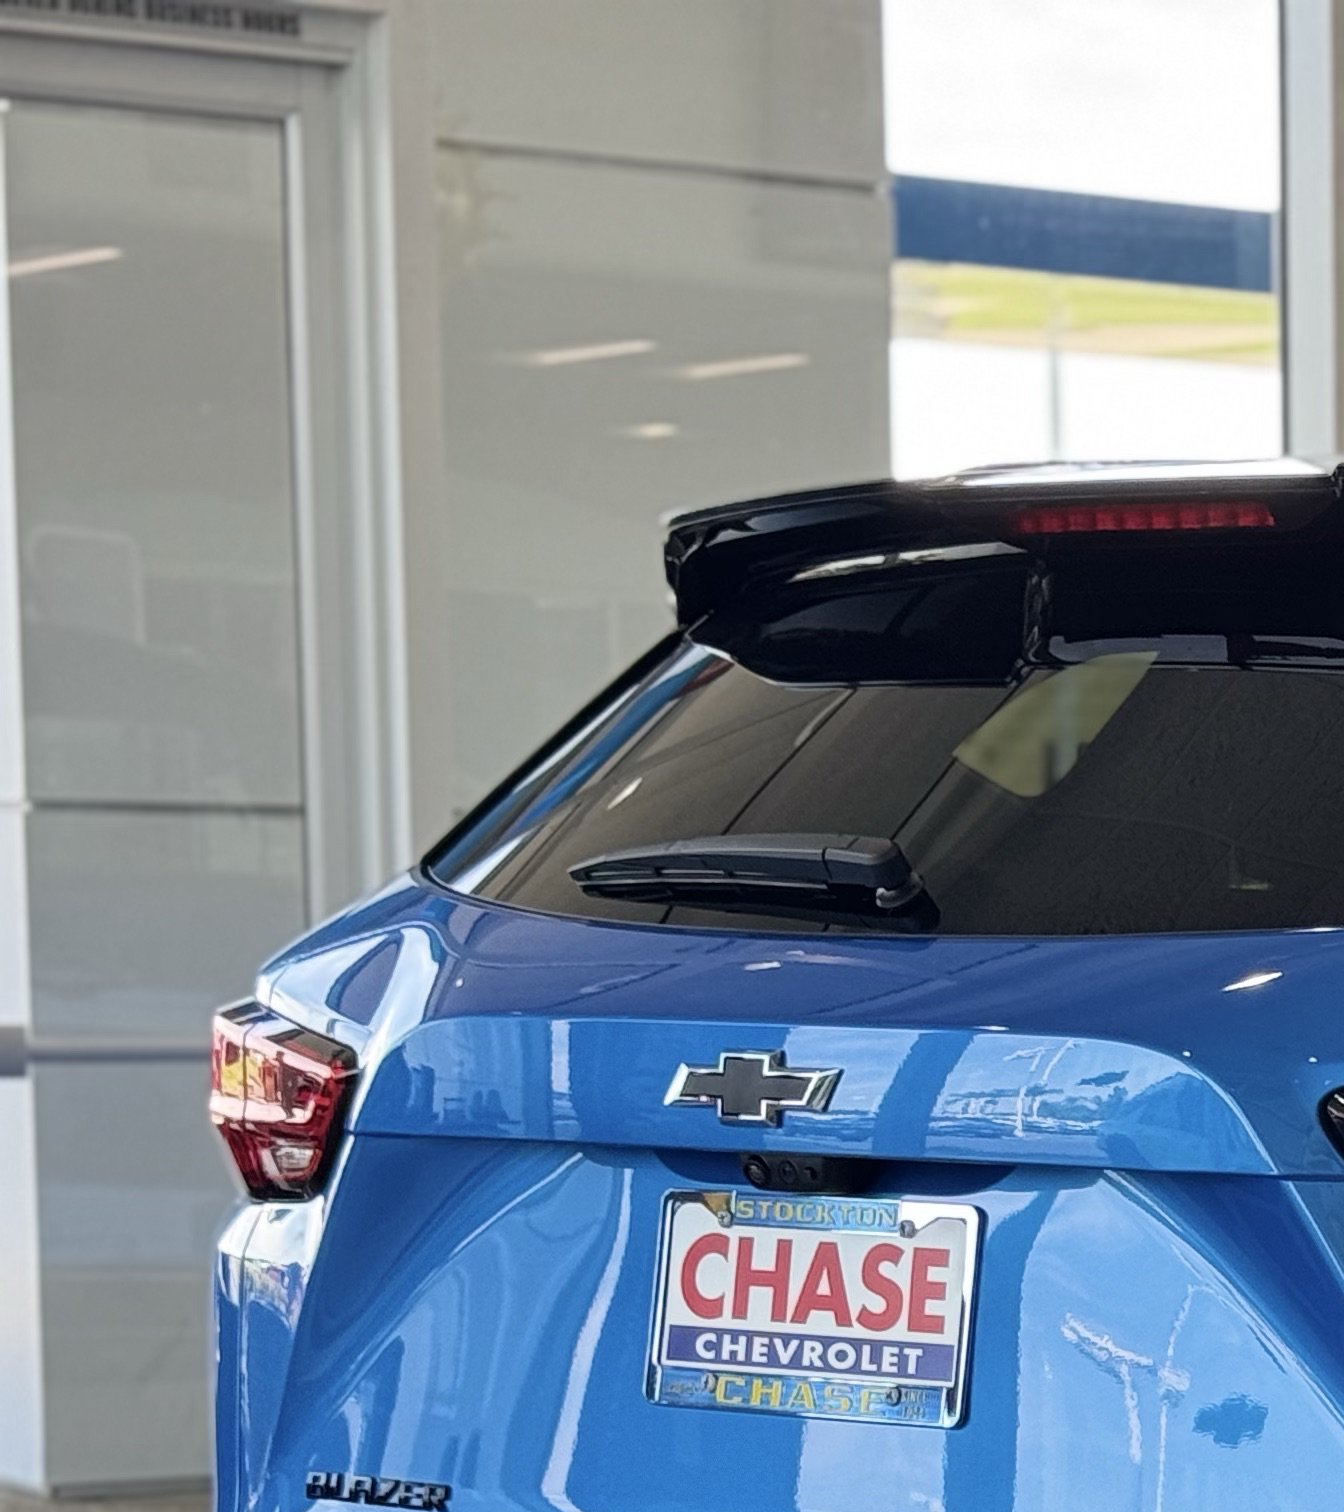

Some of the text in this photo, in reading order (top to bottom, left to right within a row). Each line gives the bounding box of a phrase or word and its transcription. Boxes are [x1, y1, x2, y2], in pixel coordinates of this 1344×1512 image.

[735, 1199, 899, 1228] STOCKTON
[681, 1232, 950, 1334] CHASE
[695, 1333, 924, 1374] CHEVROLET
[714, 1375, 887, 1417] CHASE
[306, 1471, 452, 1512] BLAZER
